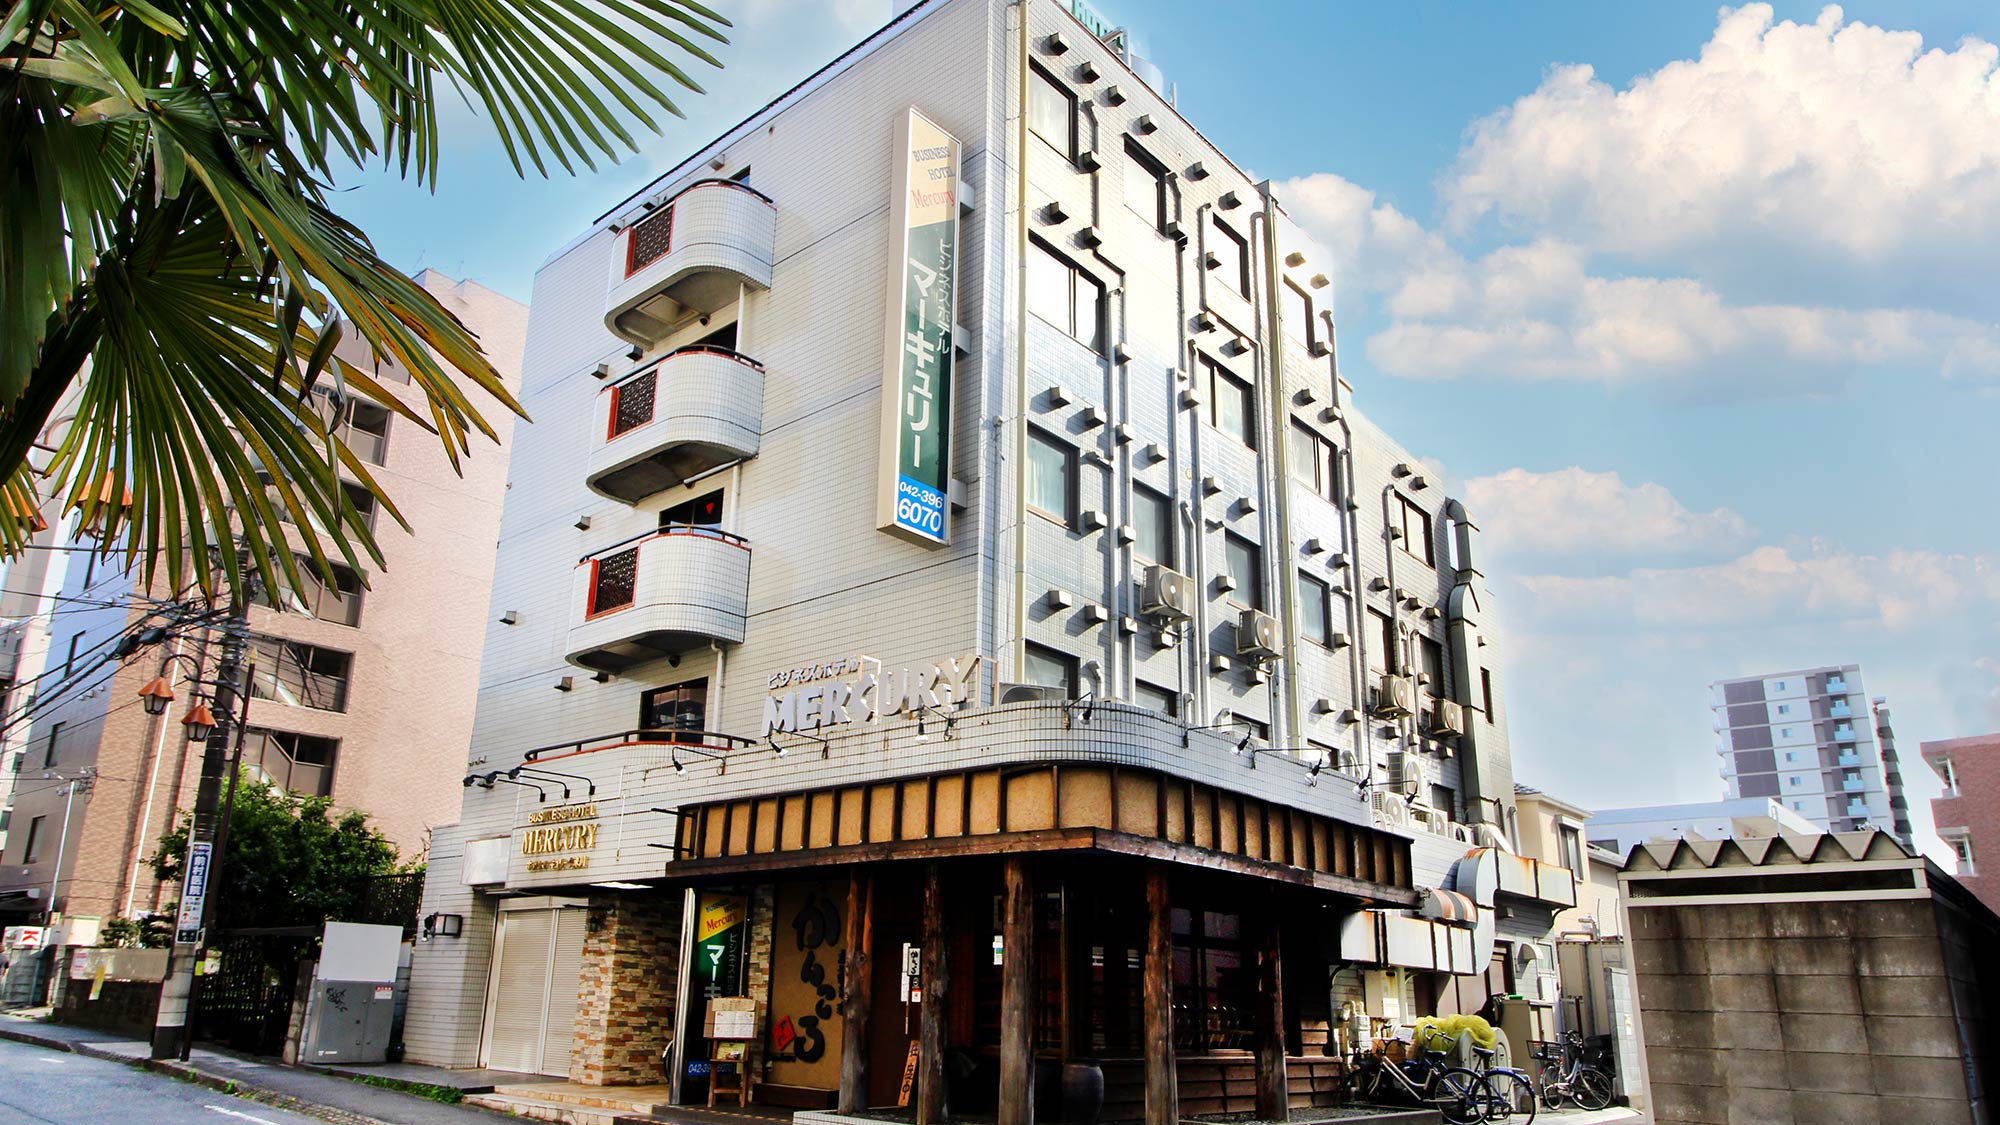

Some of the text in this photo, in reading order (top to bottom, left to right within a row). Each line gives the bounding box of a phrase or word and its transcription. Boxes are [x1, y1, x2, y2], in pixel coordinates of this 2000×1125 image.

[912, 146, 951, 162] BUSINESS
[928, 166, 956, 180] HOTEL
[911, 189, 956, 208] Mercury
[905, 257, 937, 468] マーキュリー
[899, 481, 943, 509] 042-396
[898, 497, 942, 532] 6070
[761, 654, 981, 738] MERCURY
[522, 823, 600, 854] MERCURY
[706, 911, 738, 932] Mercury
